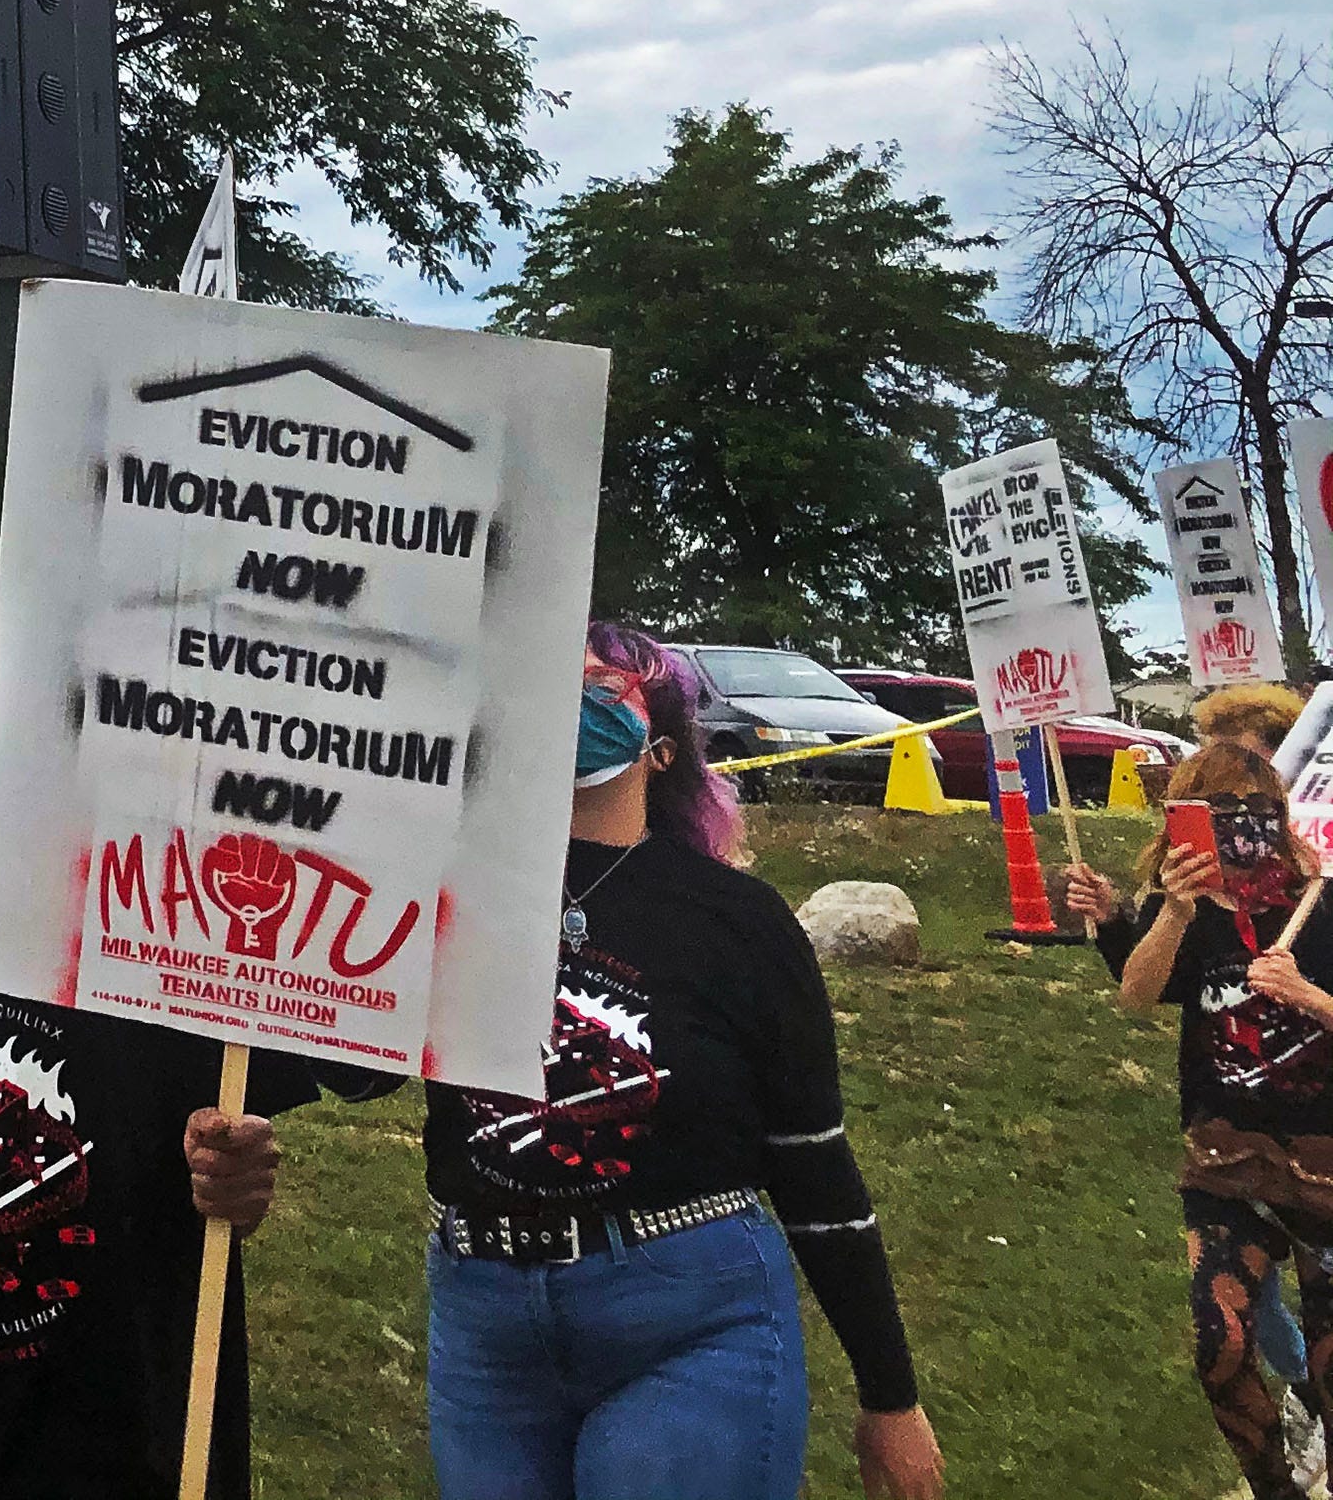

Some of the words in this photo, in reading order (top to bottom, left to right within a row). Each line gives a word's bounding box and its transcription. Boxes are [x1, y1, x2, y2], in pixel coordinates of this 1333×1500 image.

[199, 406, 410, 475] EVICTION
[122, 454, 479, 559] MORATORIUM
[1003, 473, 1039, 496] STOP
[1007, 498, 1034, 519] THE
[237, 550, 366, 608] NOW
[959, 556, 1012, 600] RENT
[178, 628, 388, 700] EVICTION
[98, 674, 454, 786] MORATORIUM
[212, 770, 342, 832] NOW
[100, 934, 230, 977] MILWAUKEE
[235, 962, 398, 1012] AUTONOMOUS
[160, 972, 260, 1010] TENANTS
[266, 994, 337, 1025] UNION
